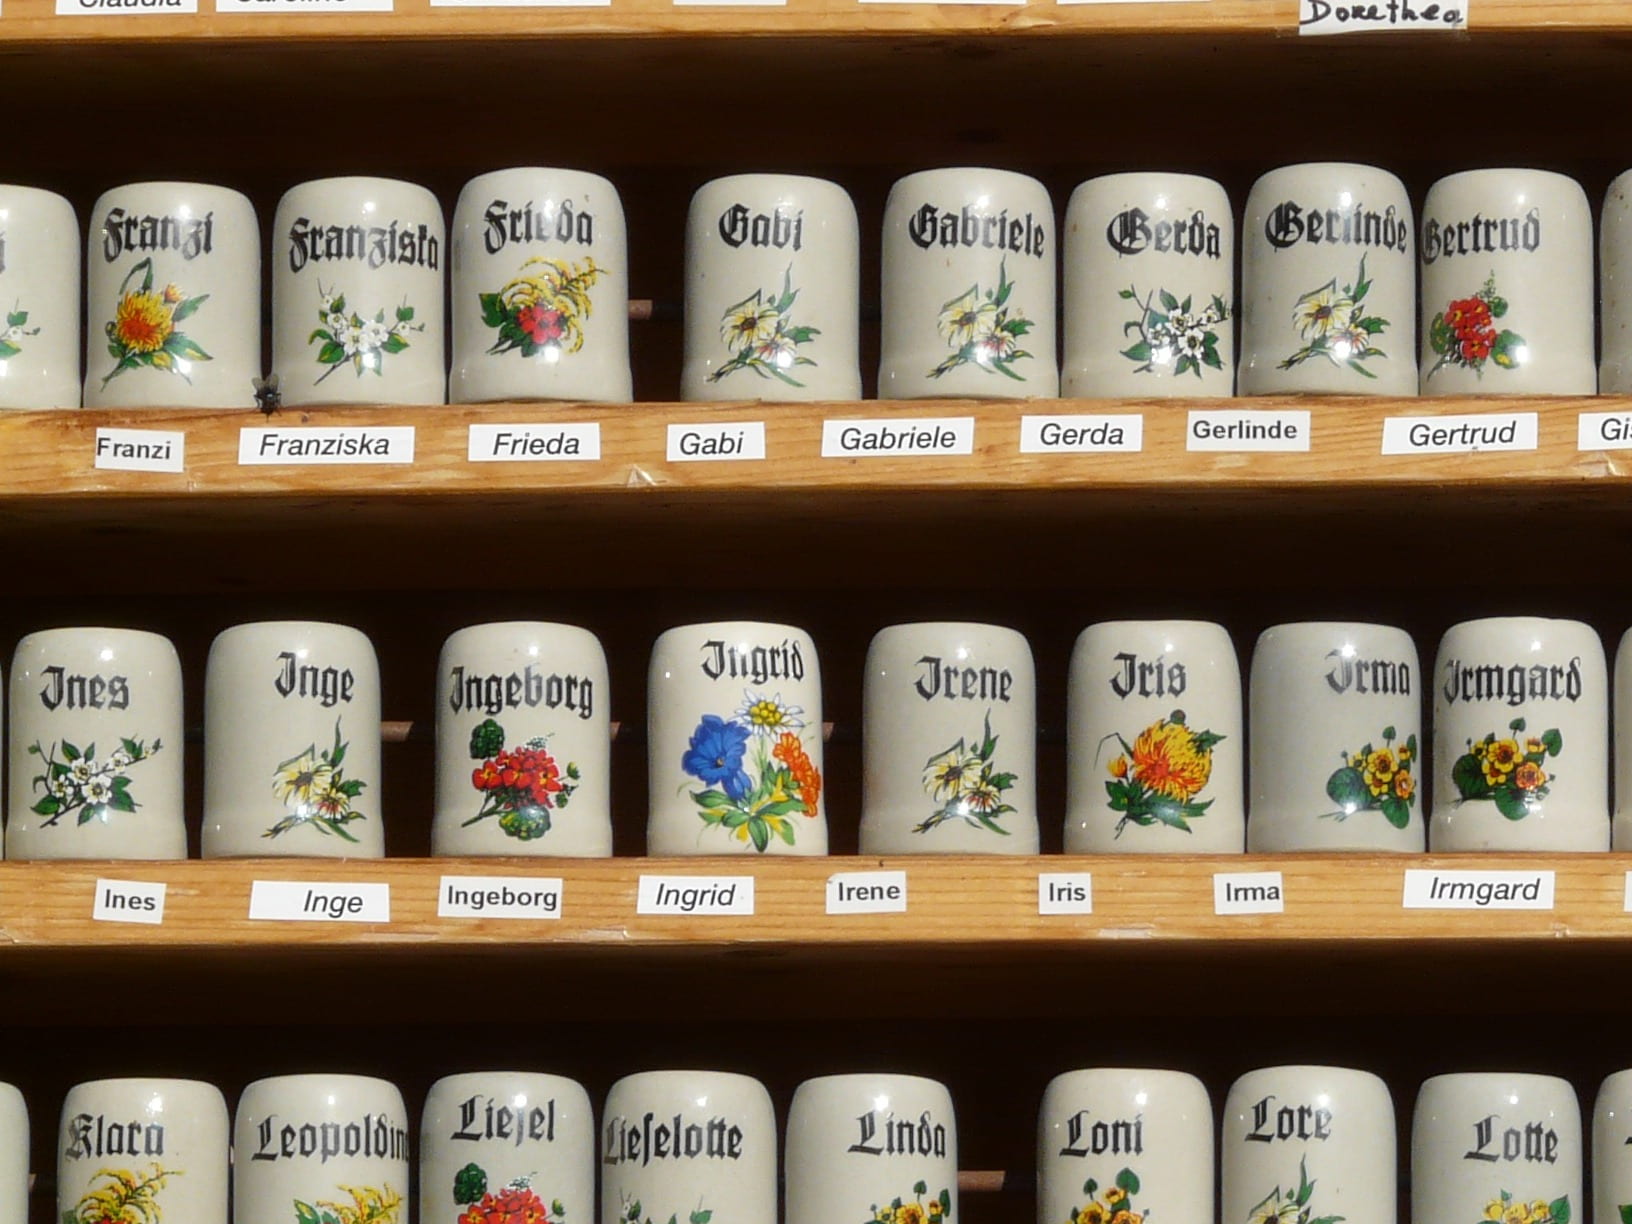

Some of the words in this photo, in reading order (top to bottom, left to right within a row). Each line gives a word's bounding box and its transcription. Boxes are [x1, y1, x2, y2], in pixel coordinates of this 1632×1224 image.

[103, 207, 214, 263] Franzi
[288, 217, 439, 274] Franziska
[718, 203, 802, 252] Gabi
[908, 203, 1045, 259] Gabriele
[1106, 207, 1221, 260] Gerda
[96, 437, 171, 460] Franzi
[259, 433, 390, 456] Franziska
[493, 432, 580, 456] Frieda
[679, 431, 744, 456] Gabi
[840, 425, 956, 451] Gabriele
[1040, 422, 1124, 446] Gerda
[1193, 420, 1298, 439] Gerlinde
[1409, 420, 1517, 447] Gertrud
[274, 651, 355, 708] Inge
[701, 639, 804, 686] Ingrid
[914, 655, 1013, 703] Irene
[1109, 652, 1186, 700] Iris
[1443, 656, 1582, 707] Irmgard
[39, 665, 129, 712] Ines
[449, 665, 593, 721] Ingeborg
[105, 889, 156, 911] Ines
[303, 890, 363, 919] Inge
[448, 885, 557, 912] Ingeborg
[656, 883, 736, 912] Ingrid
[838, 882, 901, 902] Irene
[1049, 882, 1086, 902] Iris
[1226, 882, 1280, 902] Irma
[1430, 877, 1541, 906] Irmgard
[65, 1113, 164, 1161] Klara
[847, 1111, 946, 1159] Linda
[1058, 1110, 1143, 1158] Loni
[1244, 1095, 1333, 1144] Lore
[1463, 1116, 1559, 1165] Lotte
